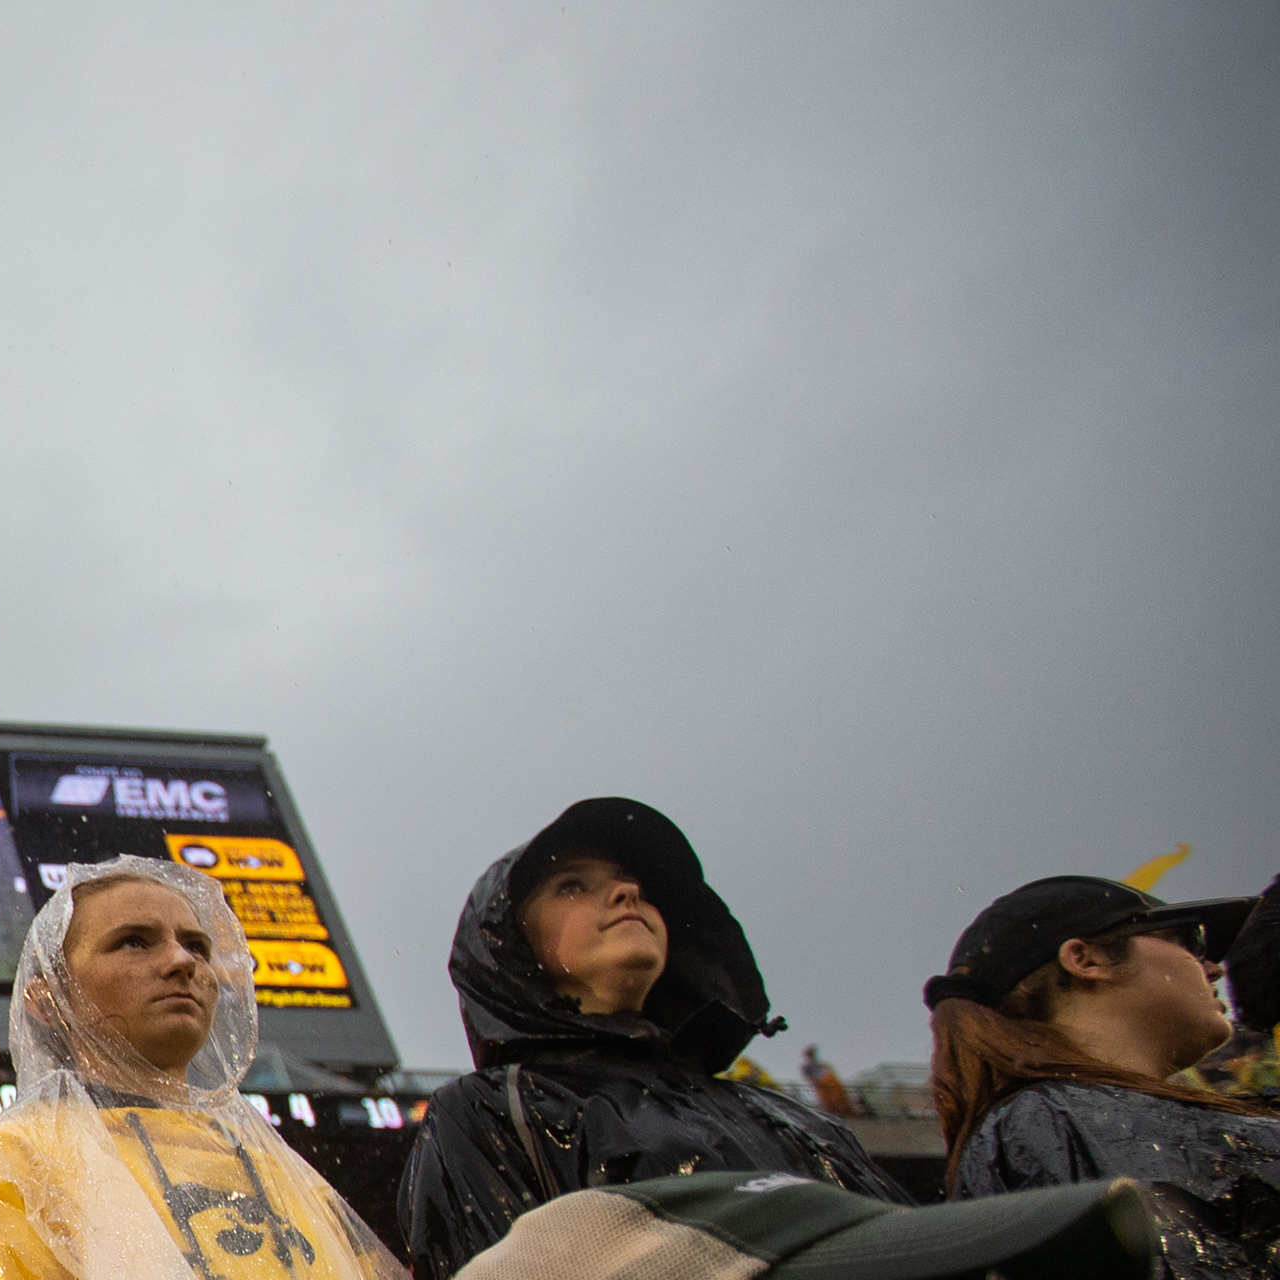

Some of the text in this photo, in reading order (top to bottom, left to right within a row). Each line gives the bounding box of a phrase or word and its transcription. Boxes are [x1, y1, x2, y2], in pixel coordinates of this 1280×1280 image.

[112, 777, 228, 812] EMC
[289, 1092, 317, 1127] 4
[362, 1096, 404, 1130] 10
